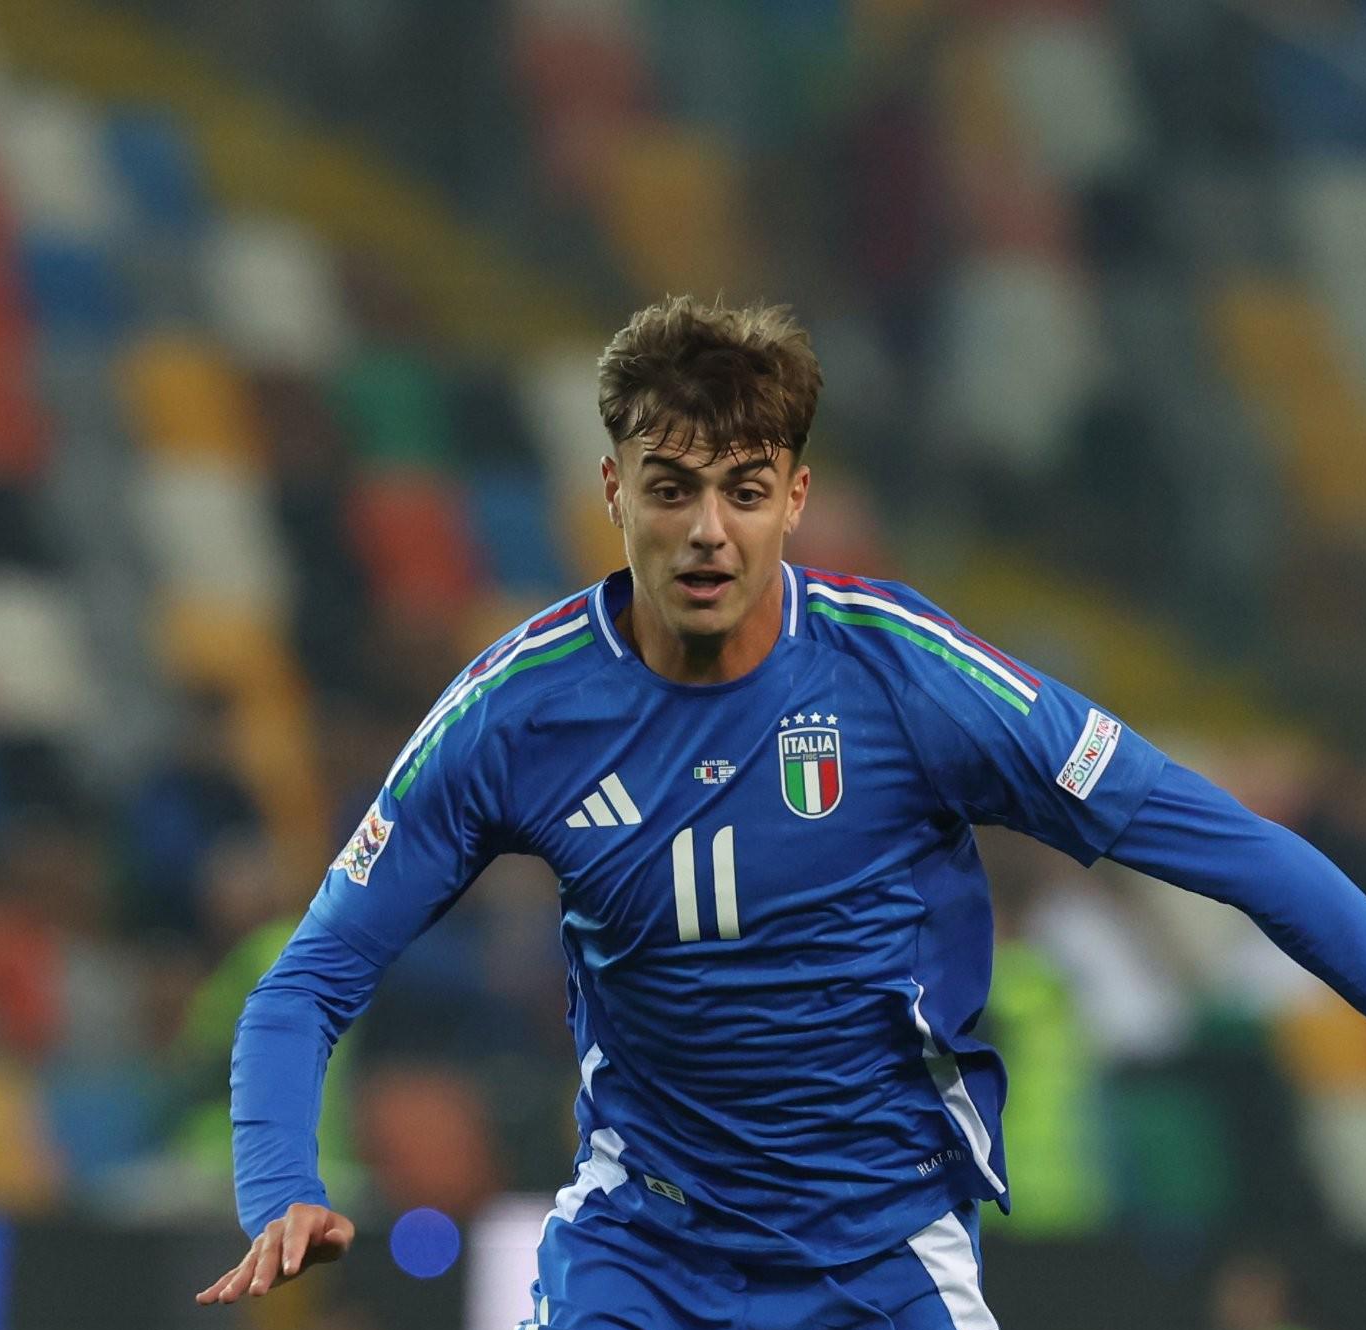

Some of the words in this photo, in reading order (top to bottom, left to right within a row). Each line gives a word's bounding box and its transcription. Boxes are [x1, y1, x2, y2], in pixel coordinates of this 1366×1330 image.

[784, 735, 835, 754] ITALIA
[1066, 716, 1110, 792] FOUNDATION
[672, 825, 741, 942] 11
